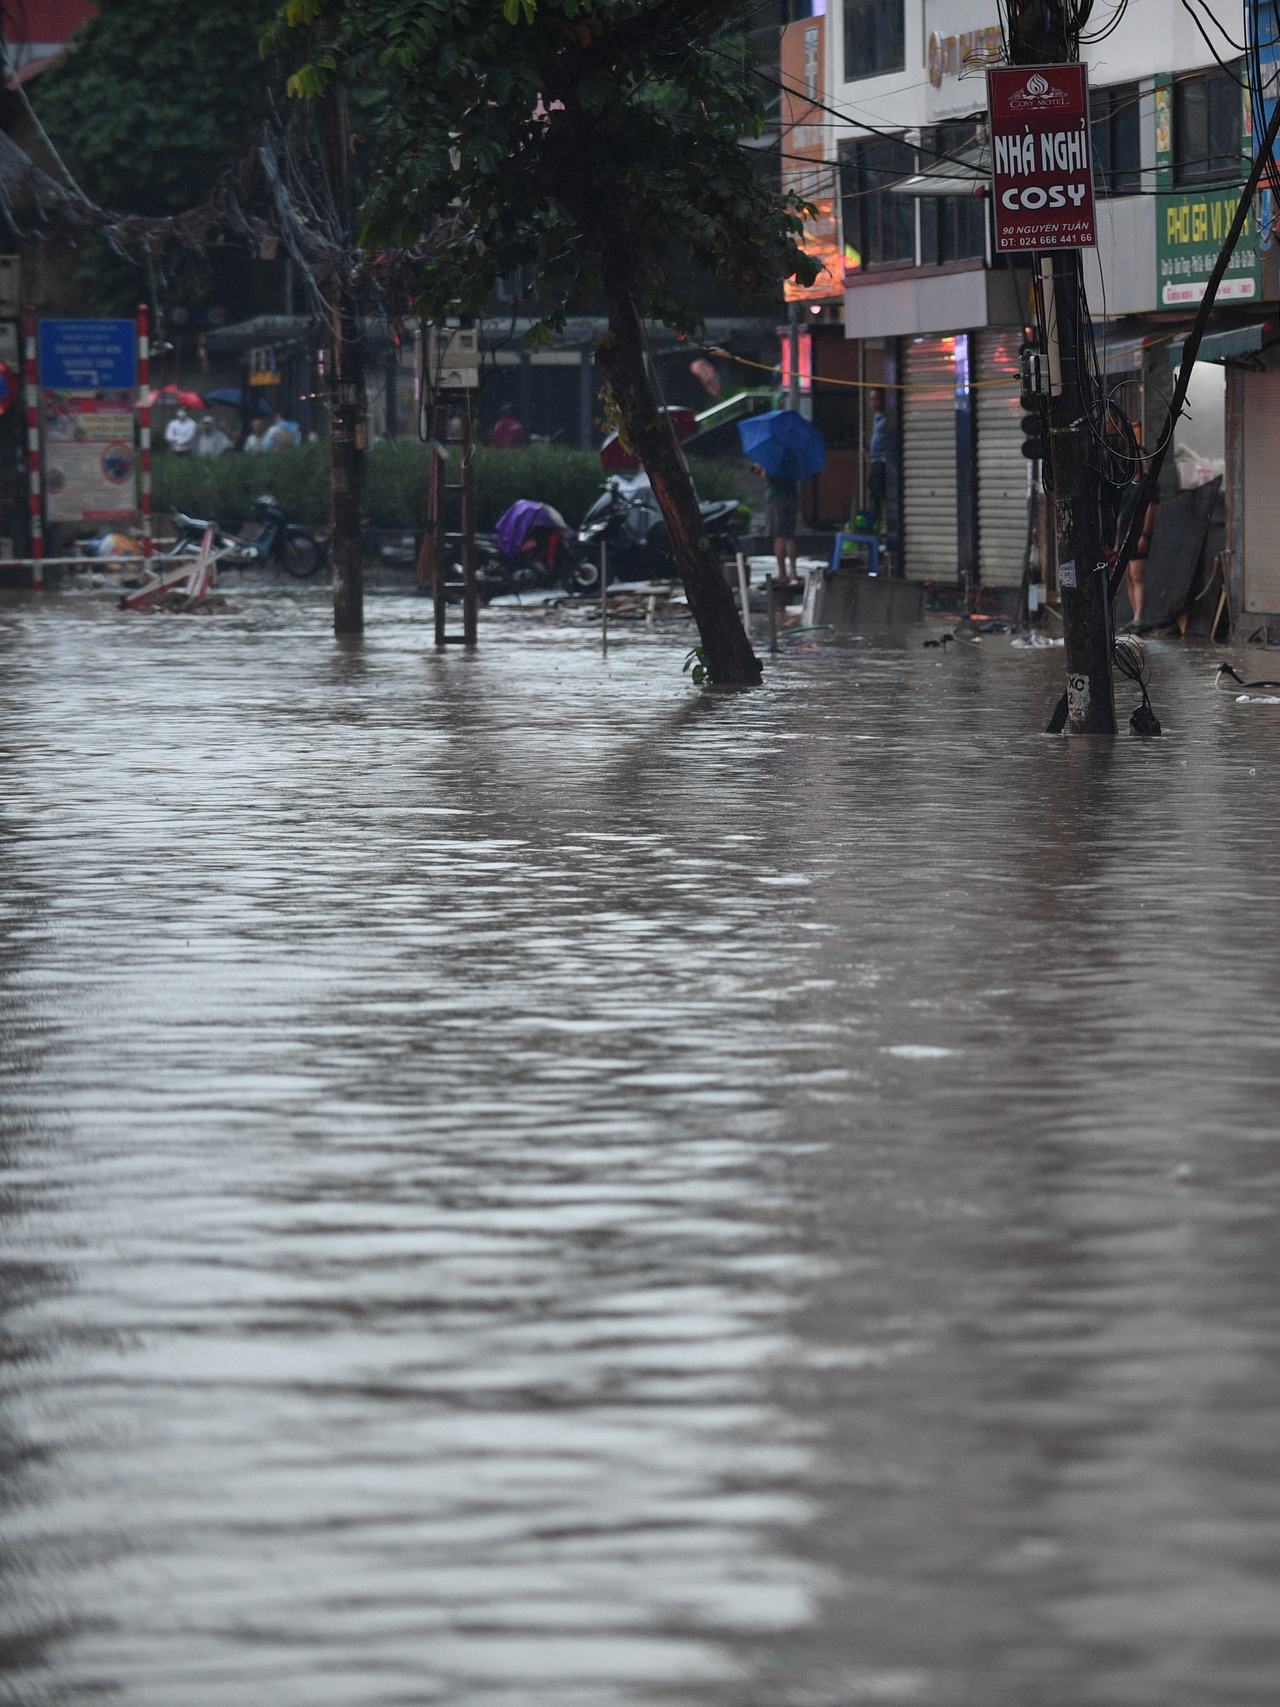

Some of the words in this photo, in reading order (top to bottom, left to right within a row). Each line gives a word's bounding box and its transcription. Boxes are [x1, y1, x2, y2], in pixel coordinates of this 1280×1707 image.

[1009, 99, 1034, 109] COSY
[1037, 97, 1070, 106] MOTEL
[994, 124, 1036, 179] NHÀ
[1040, 117, 1088, 176] NGHỈ
[1001, 183, 1086, 210] COSY
[1191, 196, 1209, 242] GÀ
[1001, 238, 1017, 247] ĐT:
[1019, 237, 1037, 246] 024
[1040, 235, 1057, 245] 666
[1060, 234, 1077, 243] 441
[1080, 233, 1093, 242] 66
[1002, 226, 1014, 235] 90
